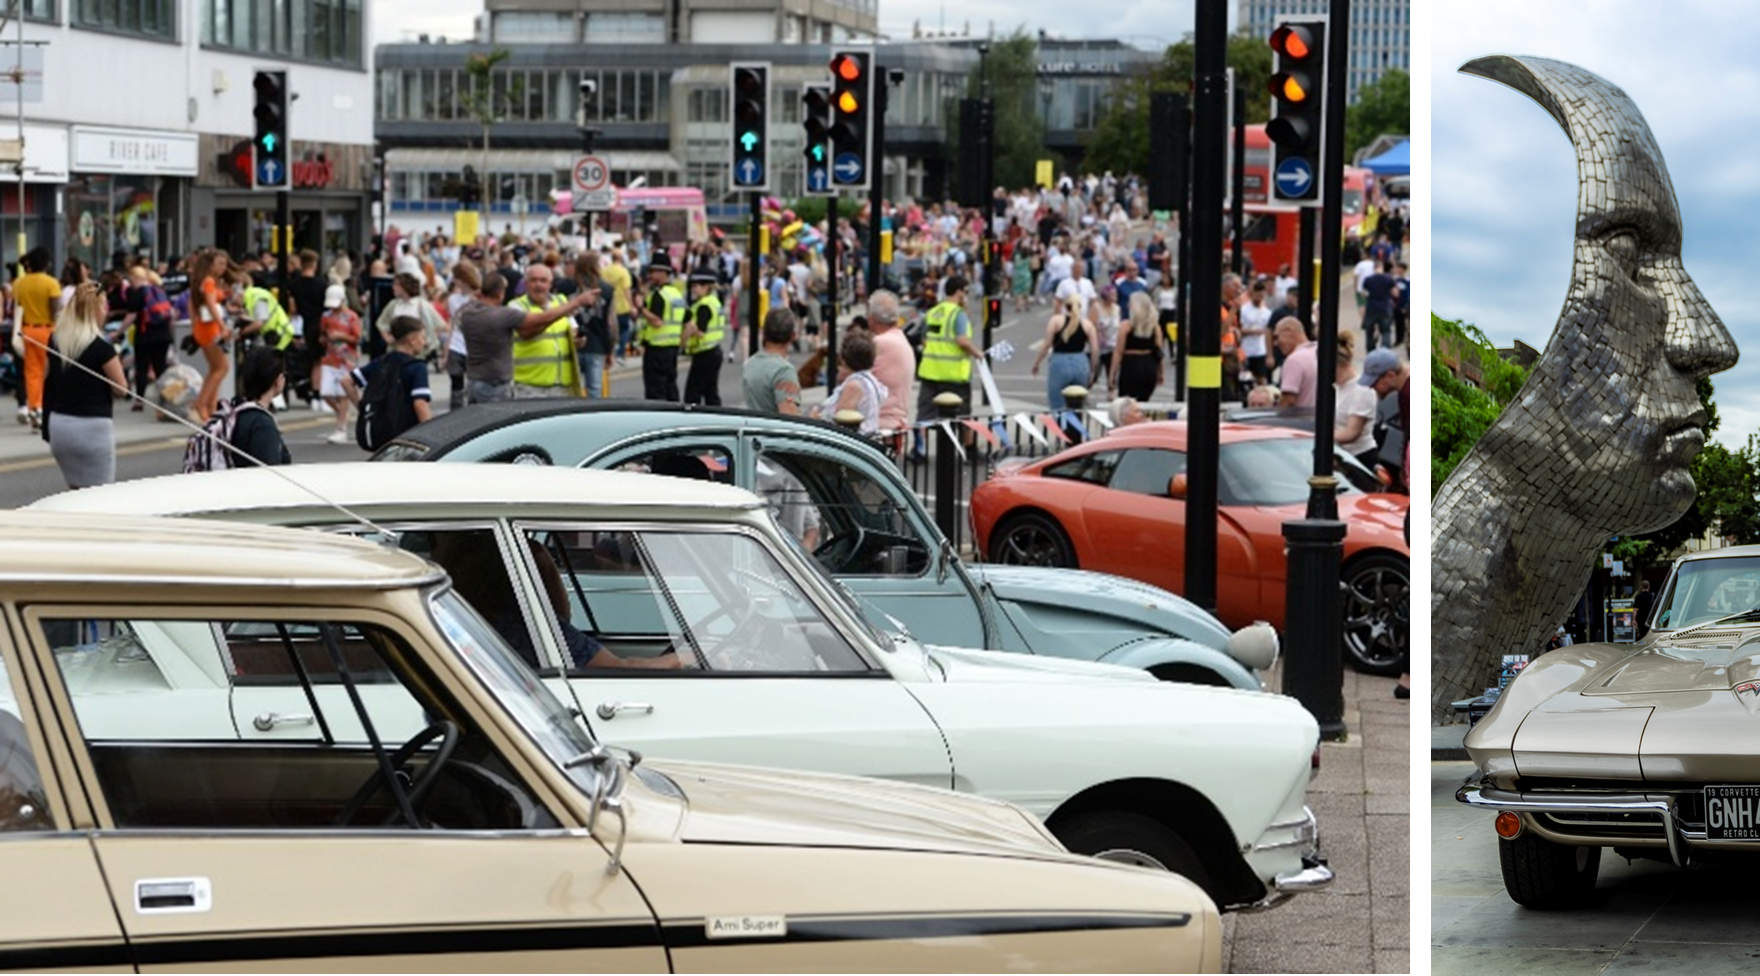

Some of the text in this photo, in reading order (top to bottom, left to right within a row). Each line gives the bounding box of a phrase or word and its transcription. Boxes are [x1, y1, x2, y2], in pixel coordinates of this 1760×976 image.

[1037, 62, 1076, 74] cure
[109, 140, 141, 161] RIVER
[580, 166, 603, 181] 30
[1708, 788, 1716, 797] 19
[1720, 788, 1759, 797] CORVETTE
[1723, 829, 1748, 838] RETRO
[712, 917, 780, 932] Ami Super
